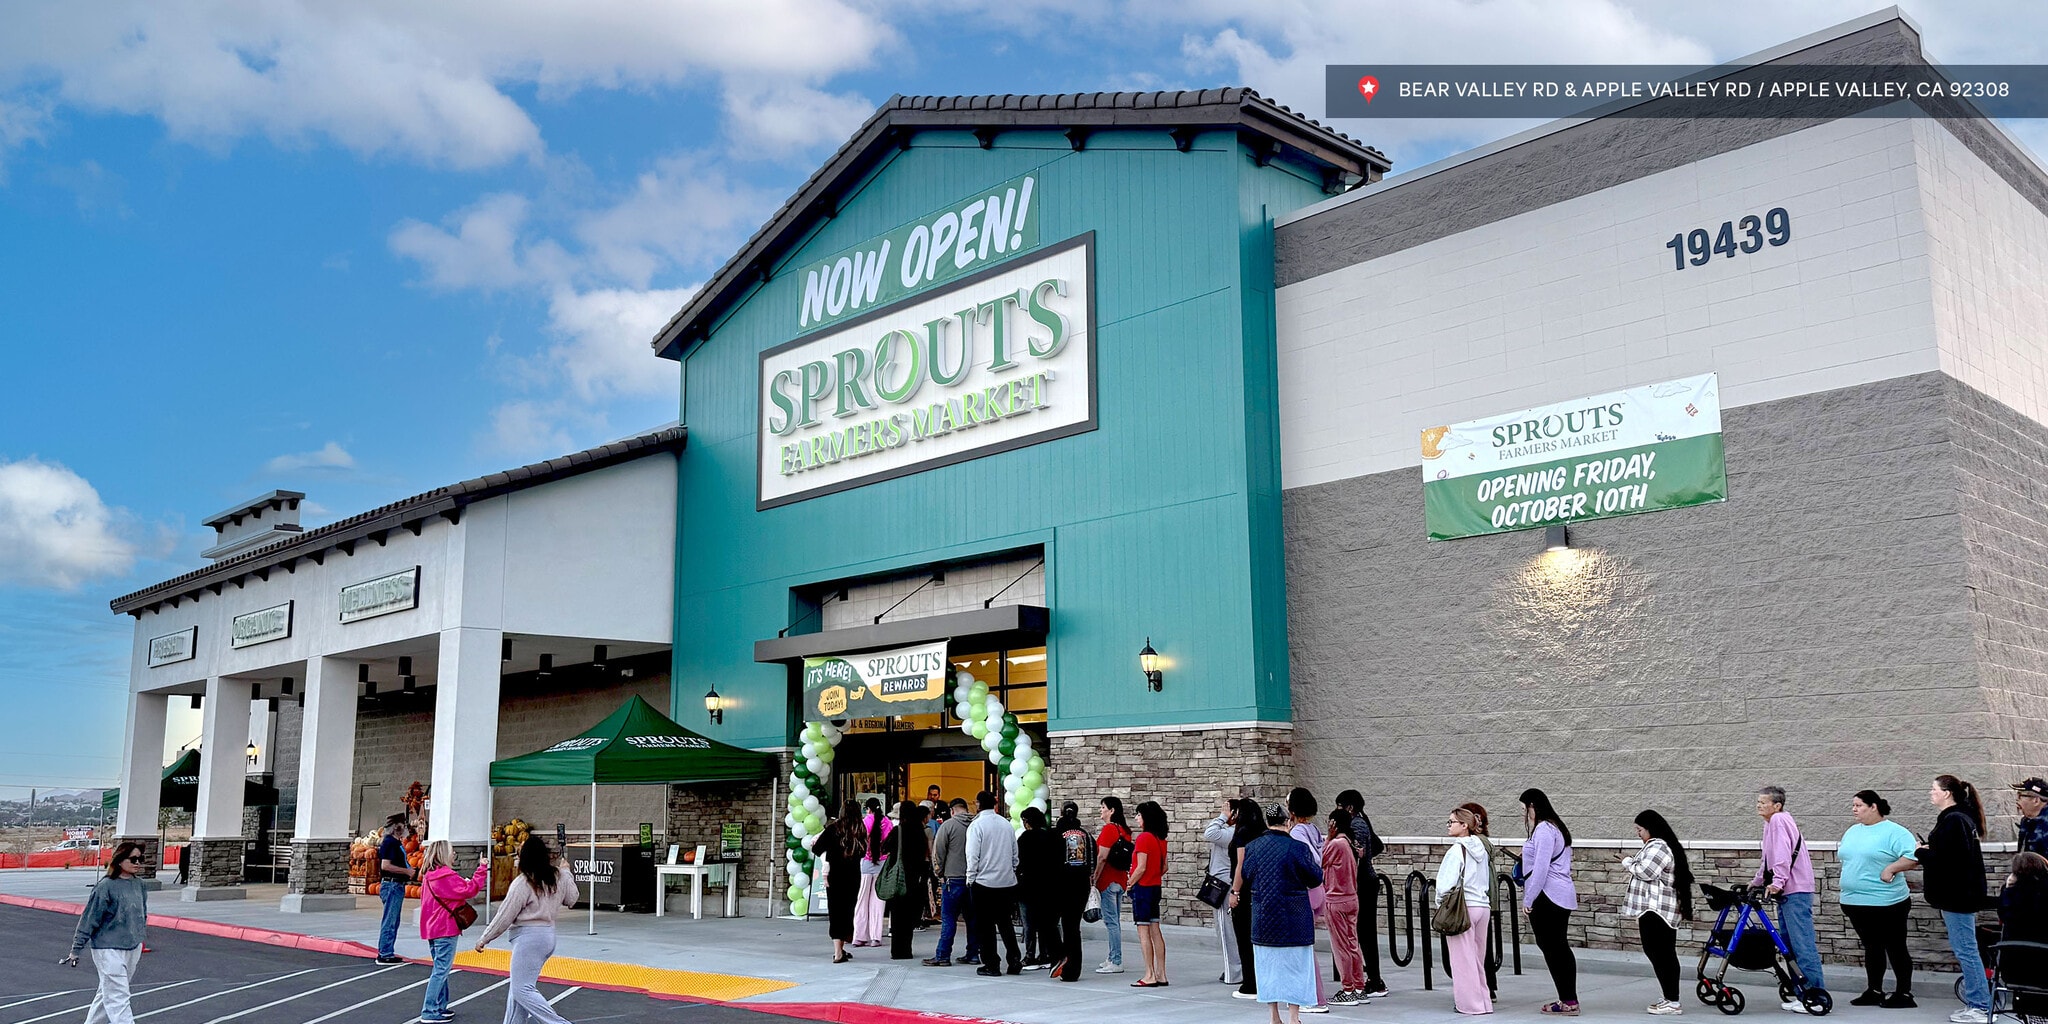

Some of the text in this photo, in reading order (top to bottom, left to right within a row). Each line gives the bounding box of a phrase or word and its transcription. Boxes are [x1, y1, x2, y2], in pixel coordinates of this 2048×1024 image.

[800, 177, 1035, 327] NOW OPEN!
[1666, 207, 1792, 271] 19439
[769, 279, 1070, 436] SPROUTS
[780, 370, 1054, 475] FARMERS MARKET
[1492, 403, 1624, 447] SPROUTS
[1498, 430, 1618, 461] FARMERS MARKET
[1477, 451, 1656, 502] OPENING FRIDAY,
[1491, 483, 1648, 528] OCTOBER 10TH
[233, 610, 283, 639] ORGANIC
[807, 661, 852, 688] IT'S HERE!
[867, 652, 942, 677] SPROUTS
[826, 689, 840, 701] JOIN
[883, 678, 926, 692] REWARDS
[894, 721, 915, 731] ARMERS
[625, 735, 710, 748] SPROUTS
[573, 859, 615, 875] SPRUTS
